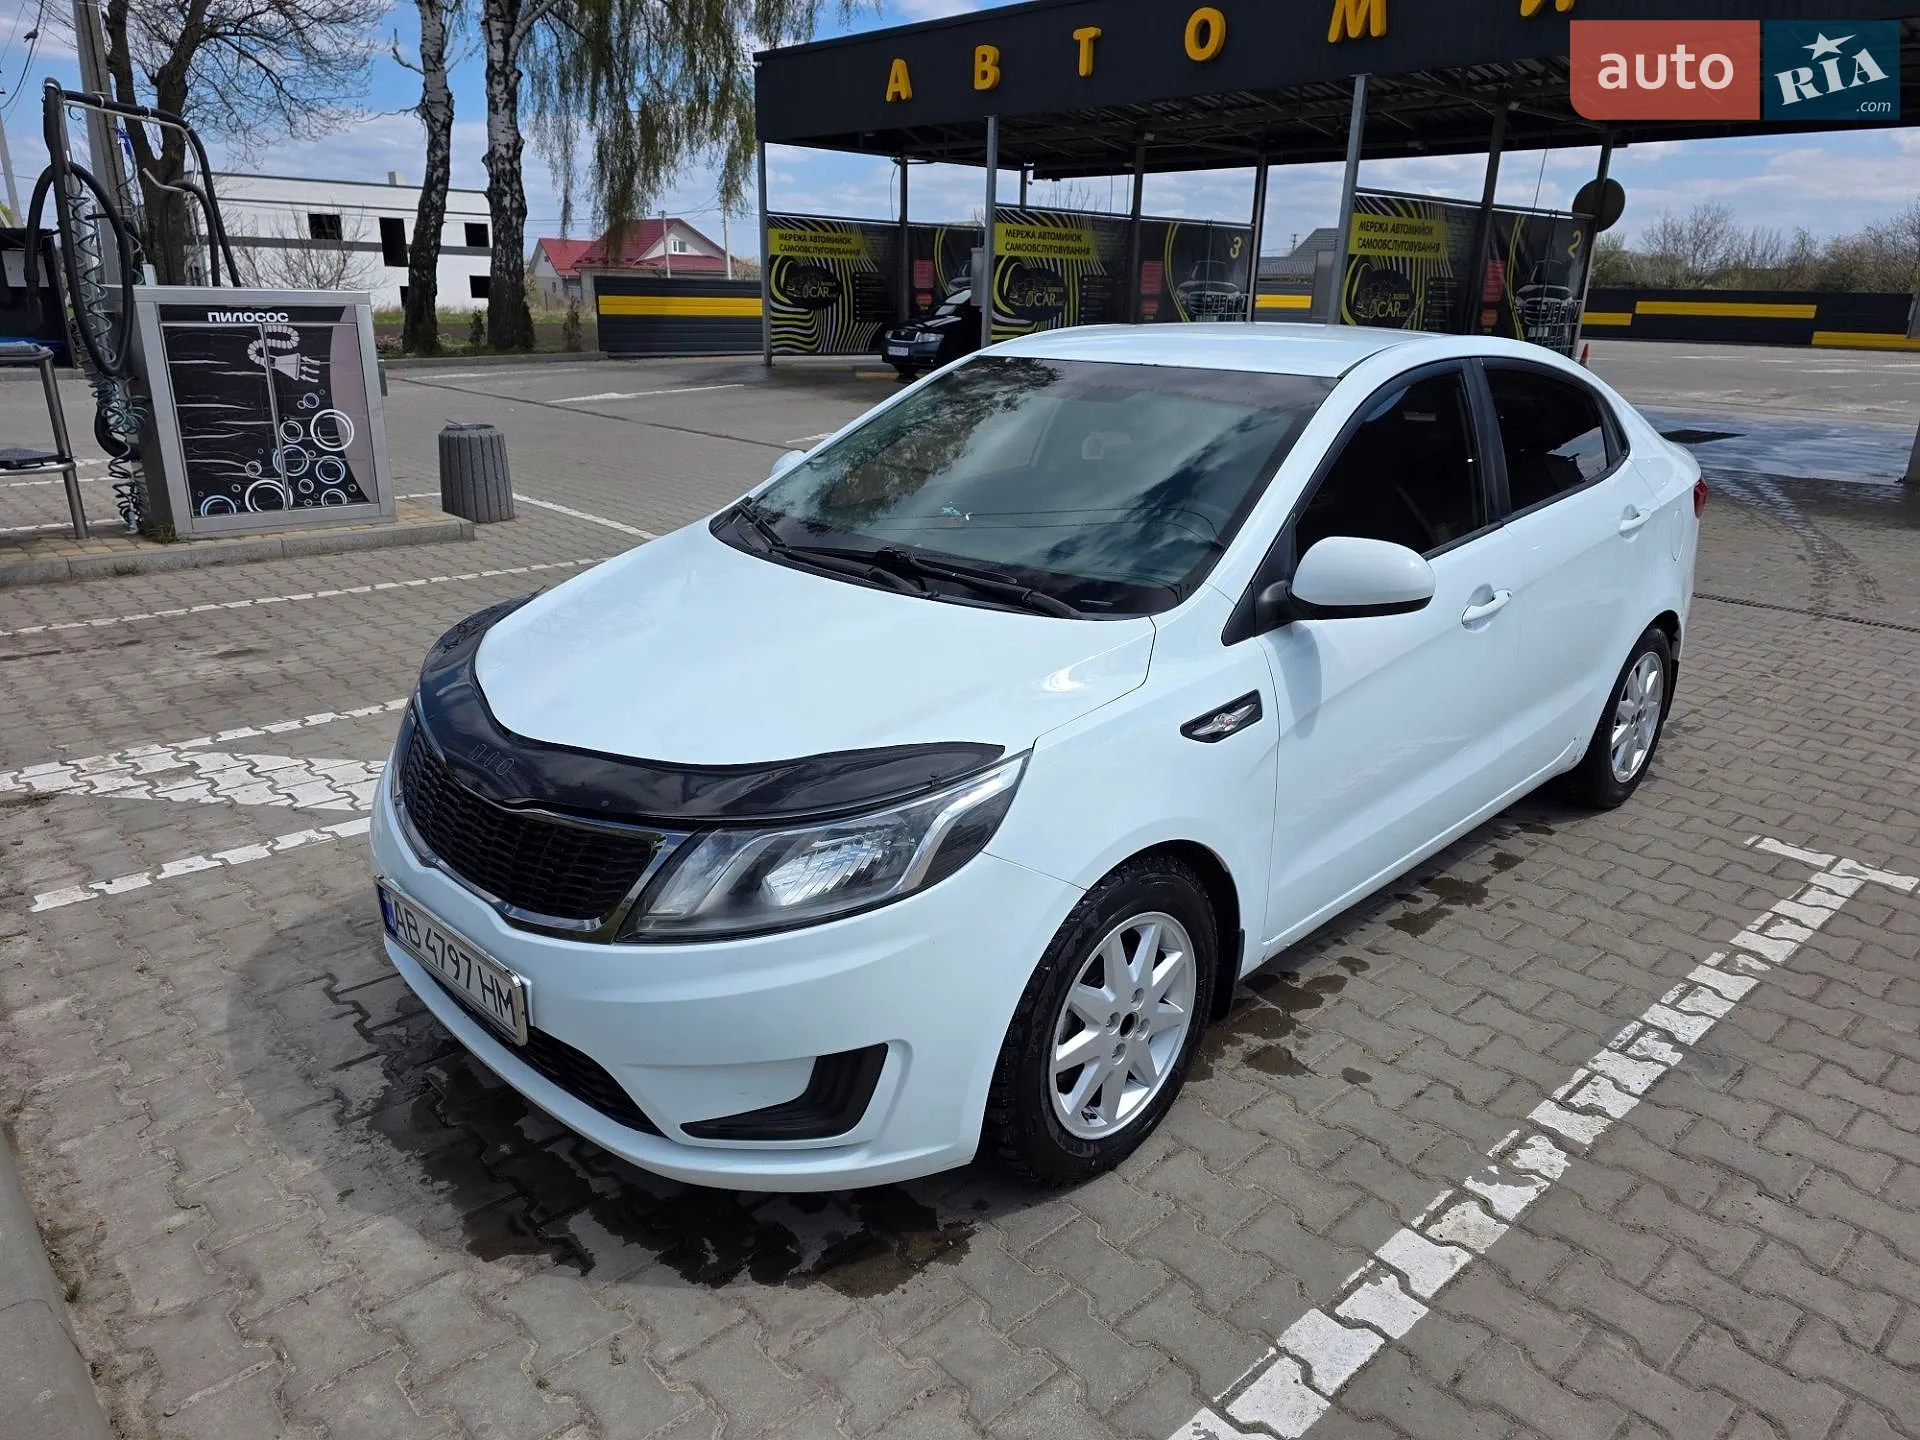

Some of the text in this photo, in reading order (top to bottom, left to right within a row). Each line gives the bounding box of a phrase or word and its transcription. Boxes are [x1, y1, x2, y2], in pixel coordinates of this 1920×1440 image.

[886, 0, 1574, 102] АВТОМ
[1005, 228, 1037, 240] МЕРЕЖА
[1358, 221, 1389, 234] МЕРЕЖА
[778, 233, 807, 243] МЕРЕЖА
[1567, 229, 1583, 259] 2
[1229, 236, 1243, 260] 3
[207, 311, 289, 323] ПИЛОСОС
[393, 900, 517, 1027] AB 4797 HM
